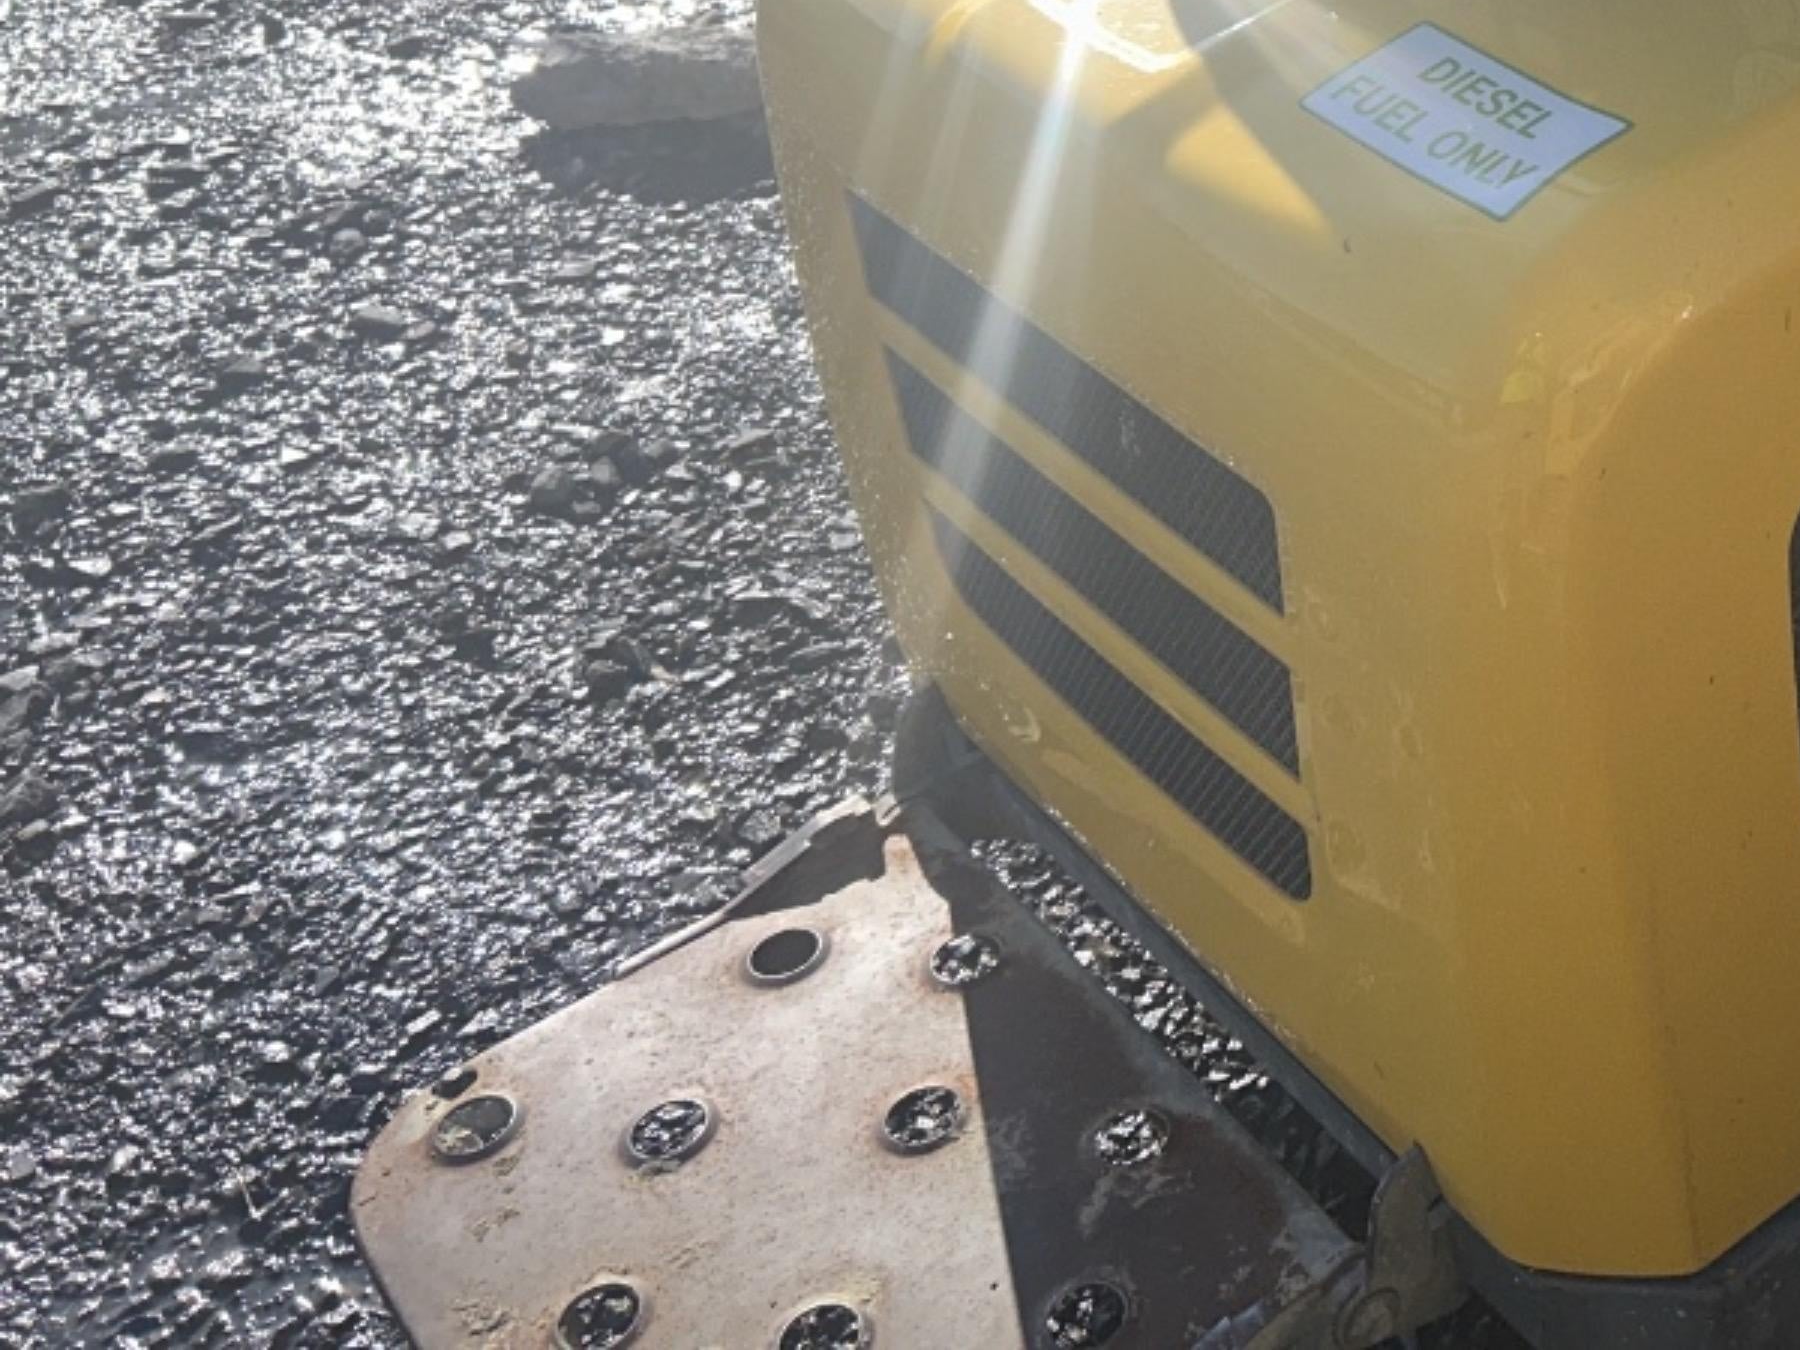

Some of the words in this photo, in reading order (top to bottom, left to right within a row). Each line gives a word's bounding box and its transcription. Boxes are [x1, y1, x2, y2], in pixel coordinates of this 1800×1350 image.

[1329, 73, 1430, 144] FUEL
[1426, 130, 1541, 189] ONLY
[1416, 55, 1553, 139] DIESEL
